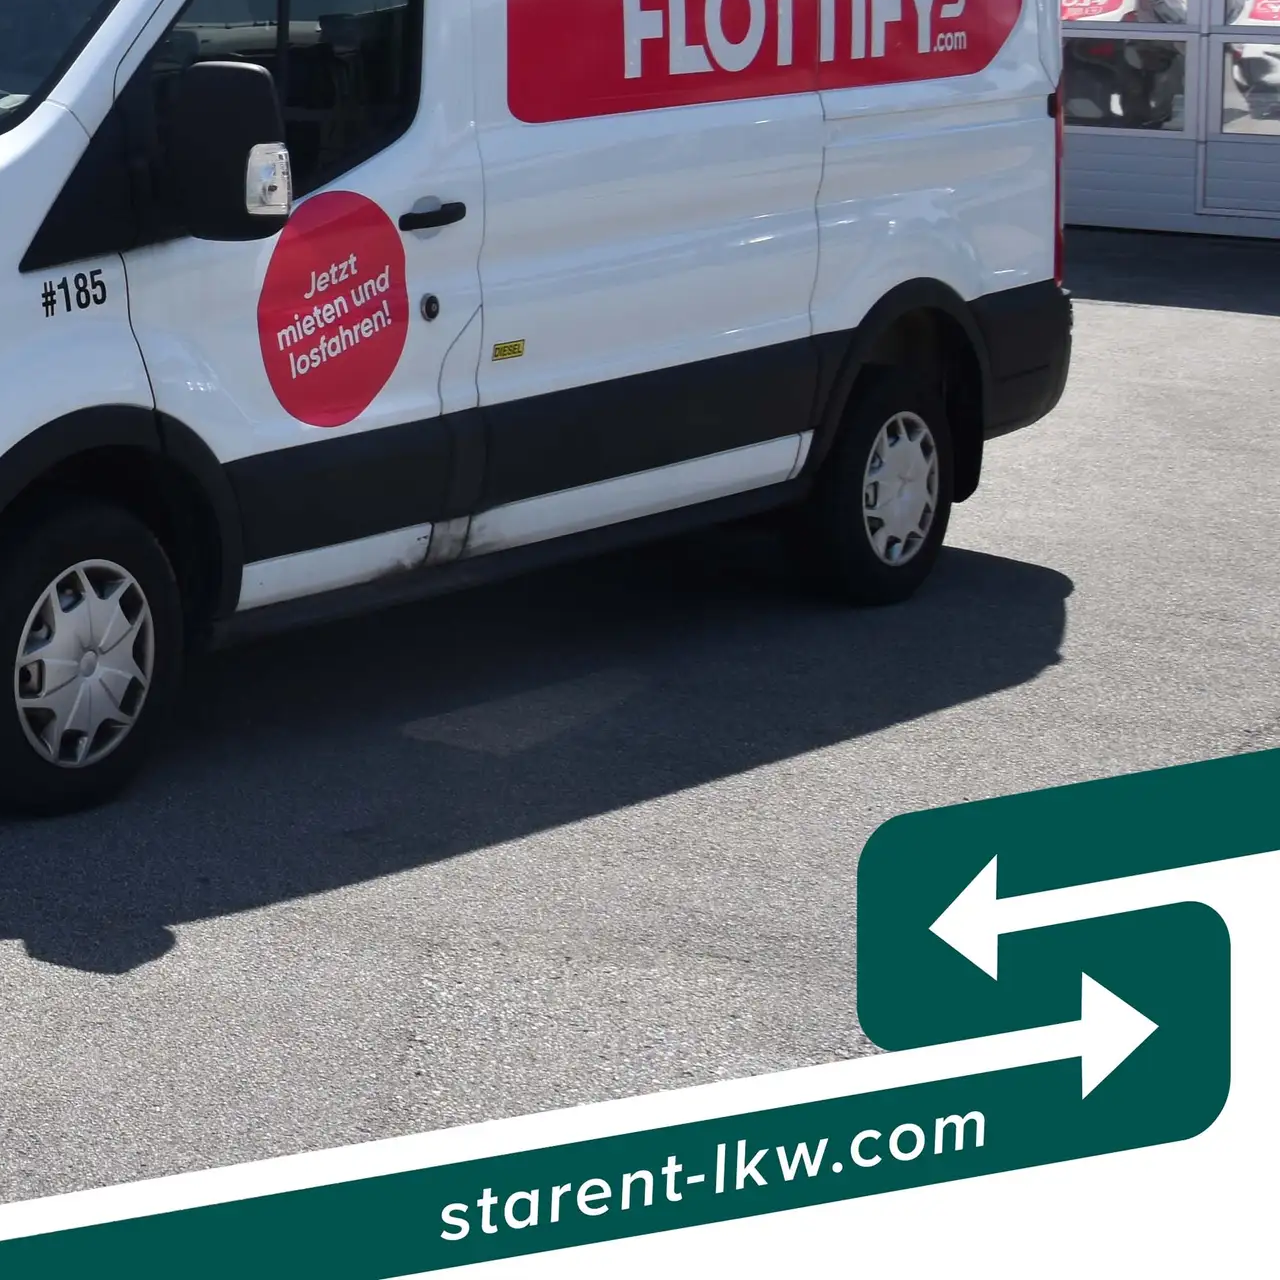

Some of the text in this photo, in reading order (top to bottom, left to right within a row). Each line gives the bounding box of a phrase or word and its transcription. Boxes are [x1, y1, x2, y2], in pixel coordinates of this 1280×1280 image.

[41, 268, 107, 318] #185
[303, 252, 358, 300] Jetzt
[276, 264, 390, 352] mieten und
[289, 299, 392, 380] losfahren!
[495, 342, 523, 358] DIESEL
